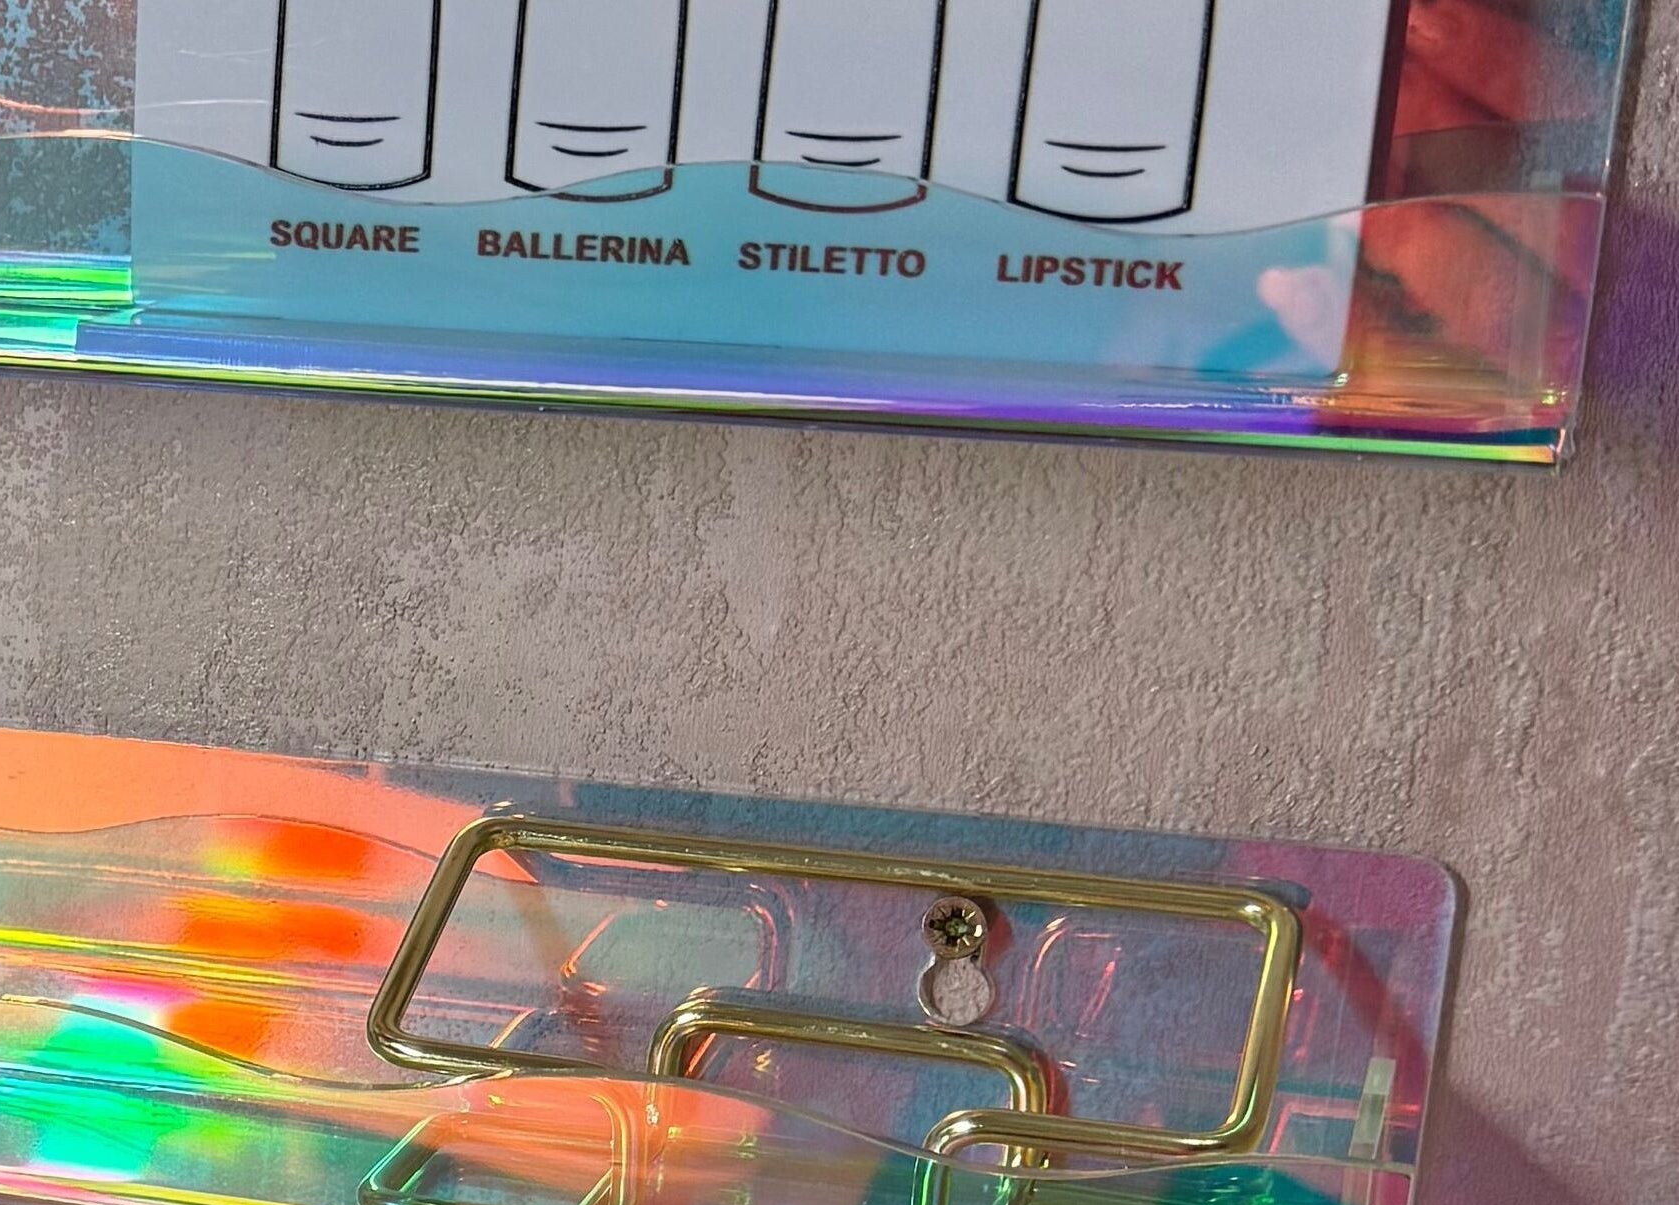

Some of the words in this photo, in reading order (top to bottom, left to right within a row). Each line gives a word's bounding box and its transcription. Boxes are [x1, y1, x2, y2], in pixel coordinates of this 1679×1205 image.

[270, 220, 420, 253] SQUARE
[477, 229, 690, 266] BALLERINA
[738, 242, 926, 278] STILETTO
[997, 254, 1184, 290] LIPSTICK
